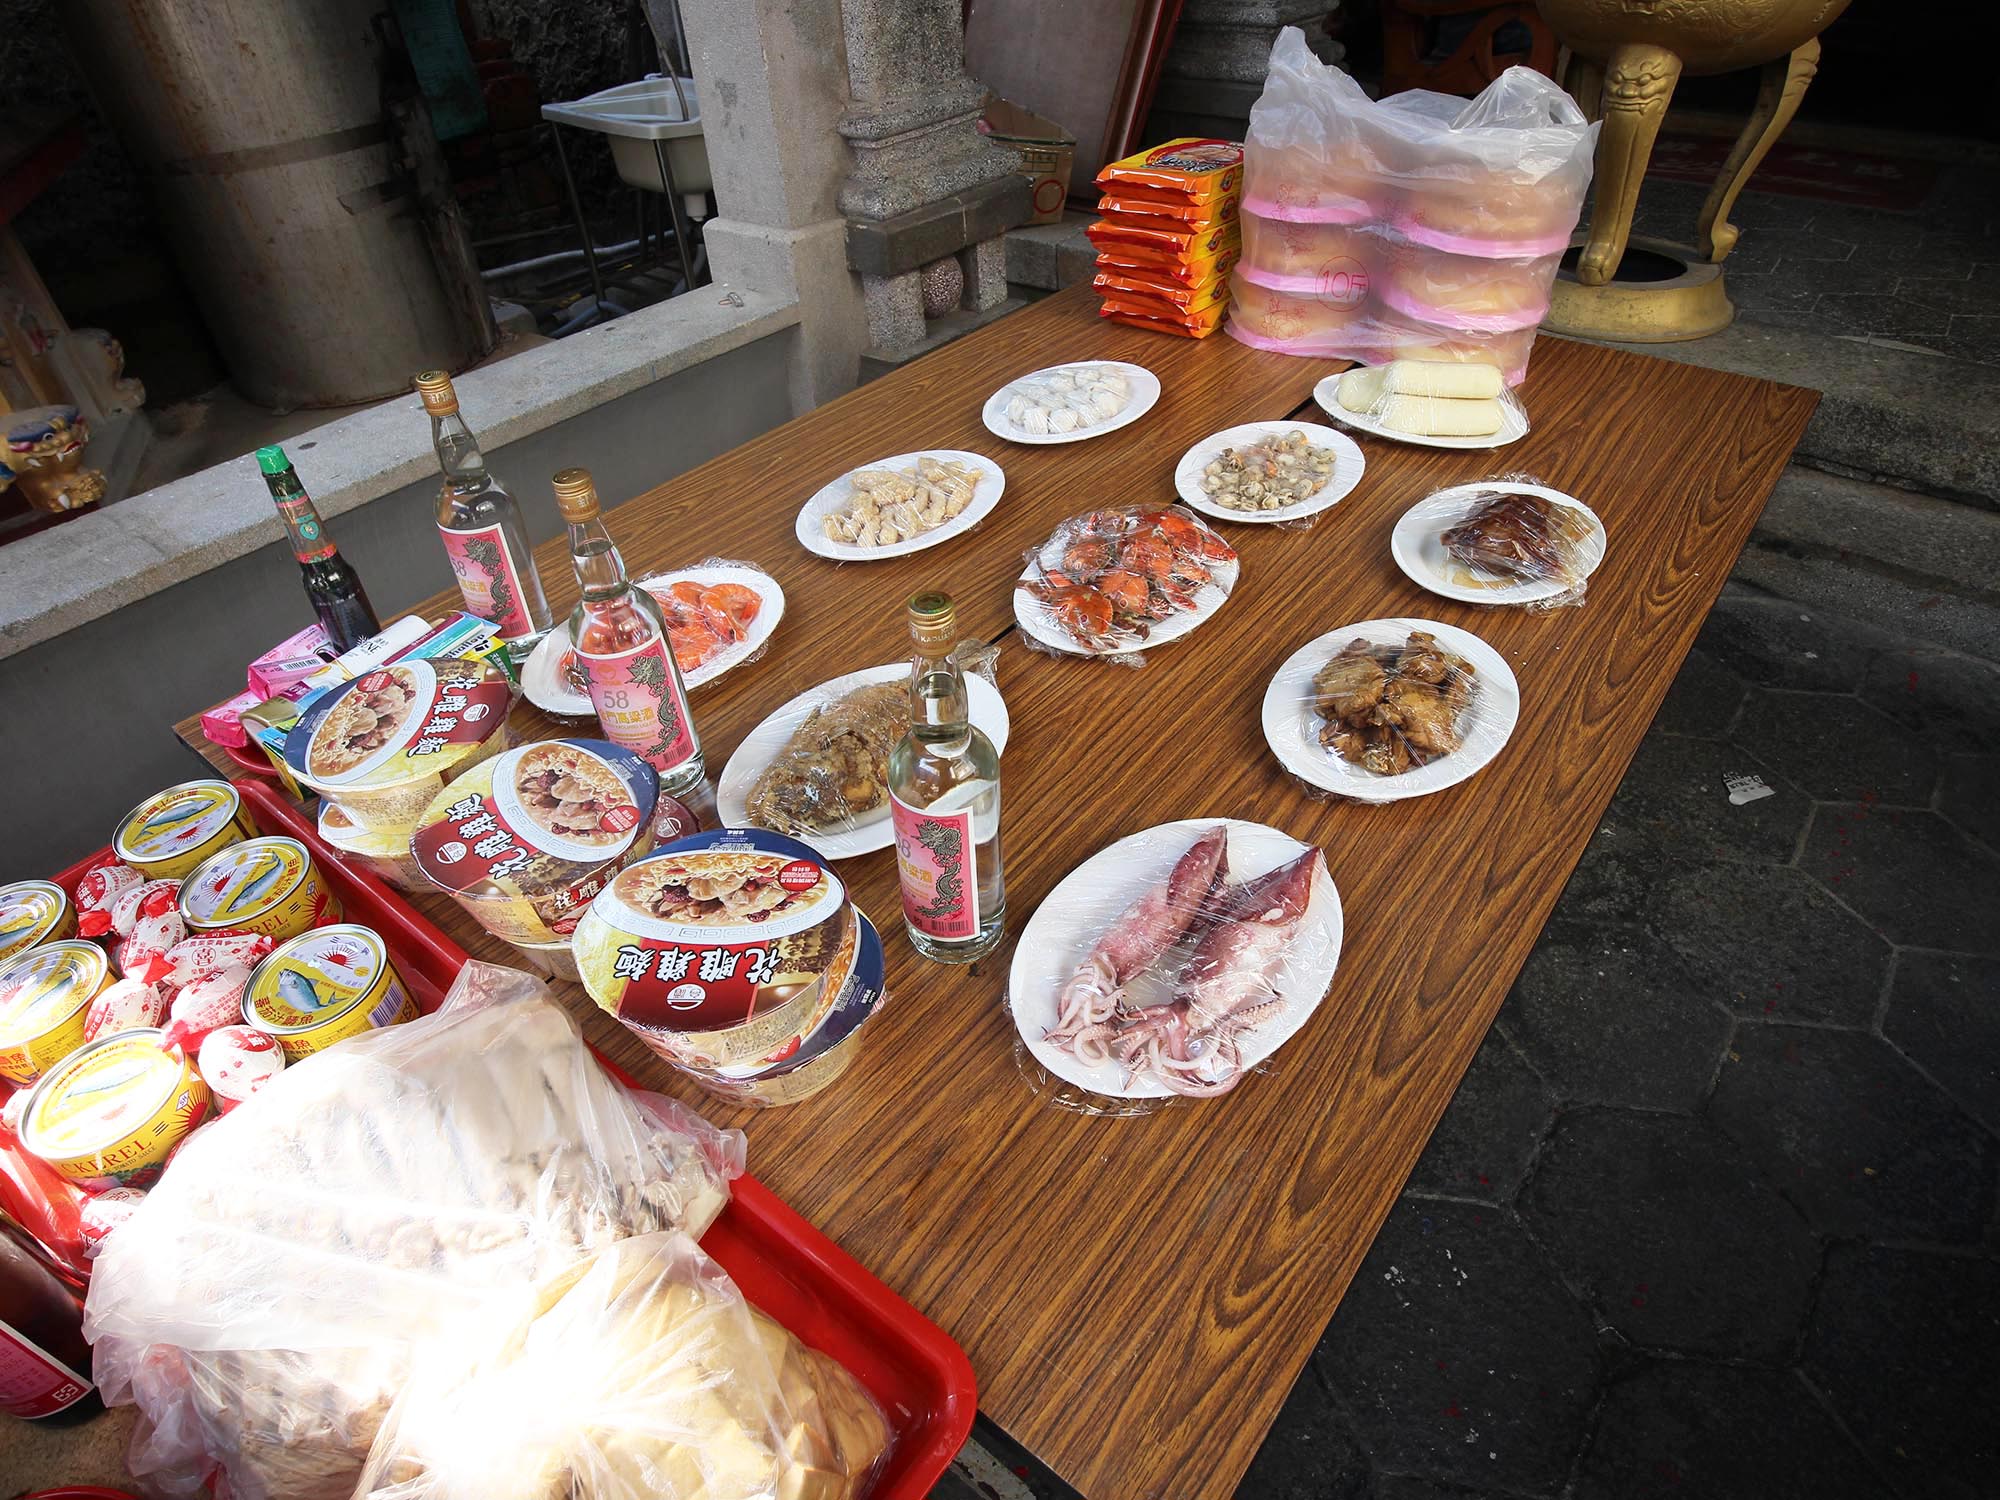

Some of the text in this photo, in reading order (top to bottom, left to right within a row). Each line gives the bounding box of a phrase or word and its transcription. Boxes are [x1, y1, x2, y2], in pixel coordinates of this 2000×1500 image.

[407, 676, 480, 757] 花雕雞麵
[603, 690, 629, 709] 58
[447, 792, 535, 879] 花雕雞麵
[613, 944, 783, 984] 花雕雞麵
